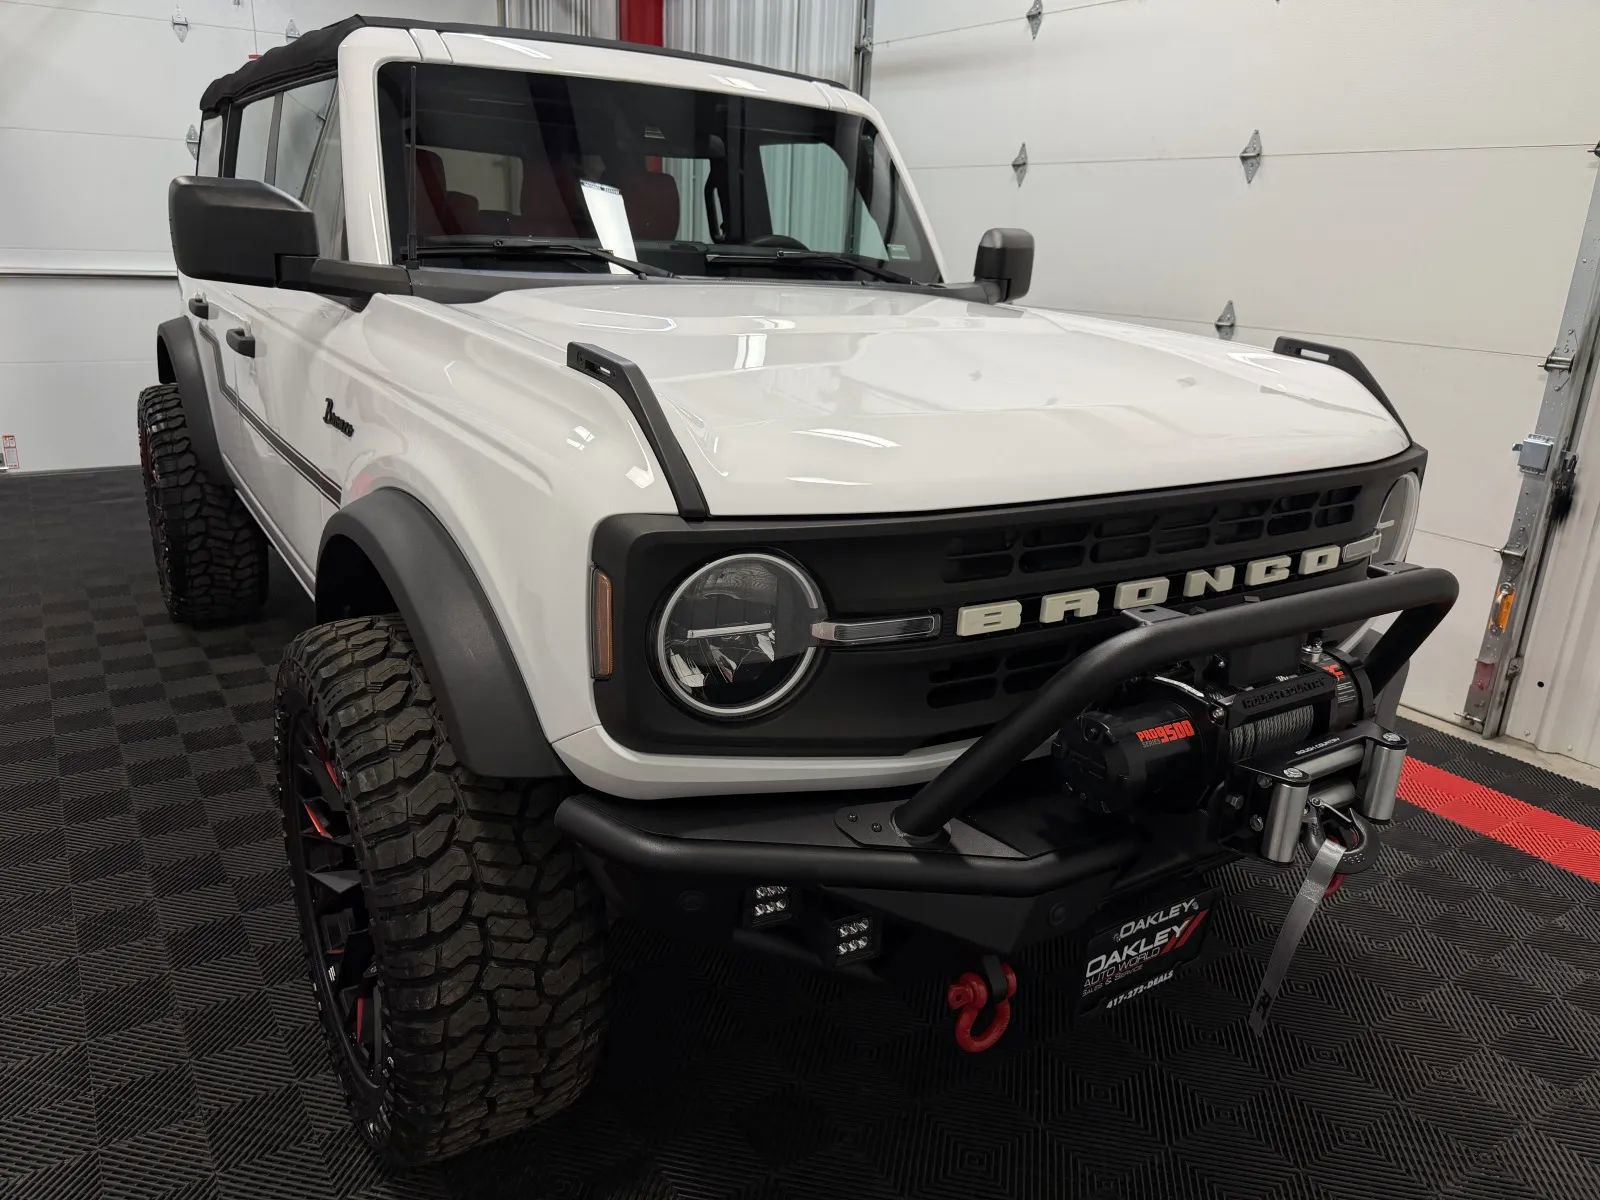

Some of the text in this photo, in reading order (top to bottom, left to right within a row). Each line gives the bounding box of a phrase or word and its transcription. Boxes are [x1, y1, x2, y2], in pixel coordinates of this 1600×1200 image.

[956, 545, 1341, 637] BRONCO
[1155, 719, 1195, 744] 9500
[1119, 897, 1196, 940] OAKLEY
[1083, 946, 1161, 987] AUTO WORLD
[1085, 919, 1191, 978] OAKLEY
